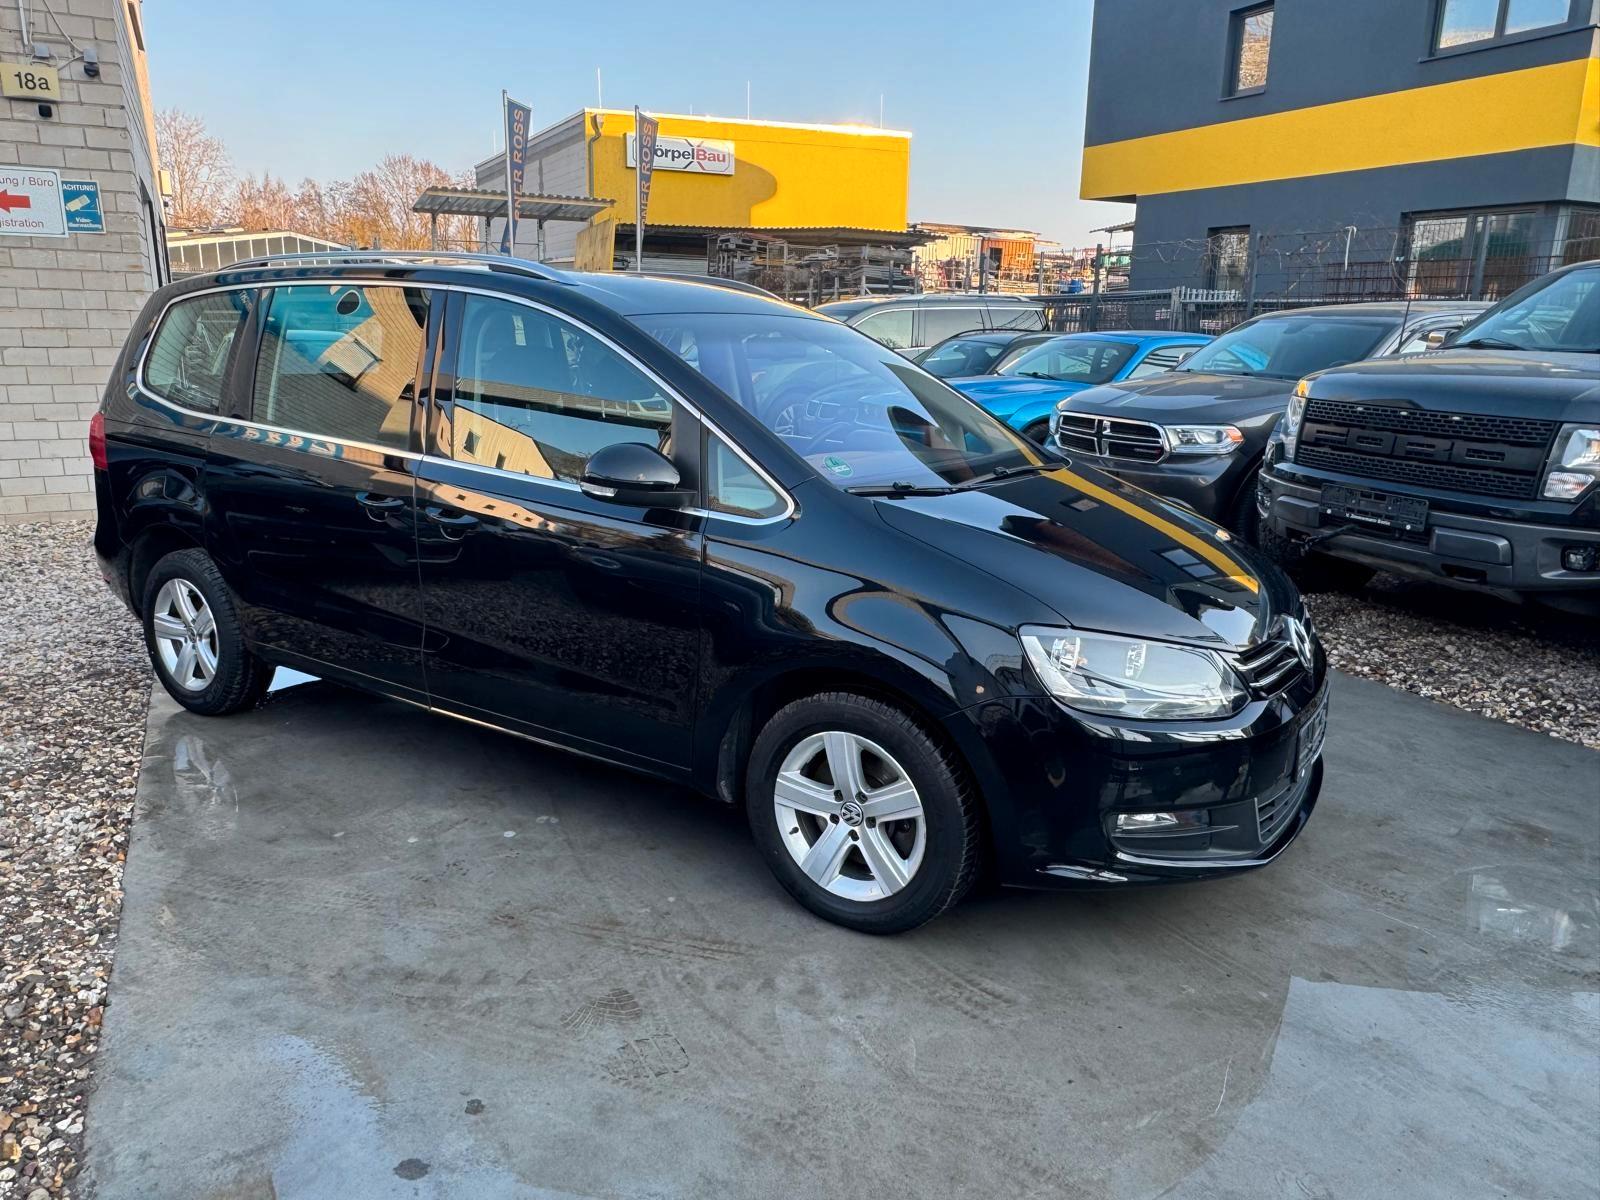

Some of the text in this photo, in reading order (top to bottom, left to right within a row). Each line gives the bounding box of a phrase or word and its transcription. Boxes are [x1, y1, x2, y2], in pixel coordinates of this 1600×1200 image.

[14, 71, 51, 91] 18a
[513, 109, 524, 164] ROSS
[642, 122, 652, 175] ROSS
[653, 144, 726, 163] örpelBau
[28, 176, 54, 187] Büro
[62, 183, 97, 192] ACHTUNG!
[0, 219, 45, 229] istration
